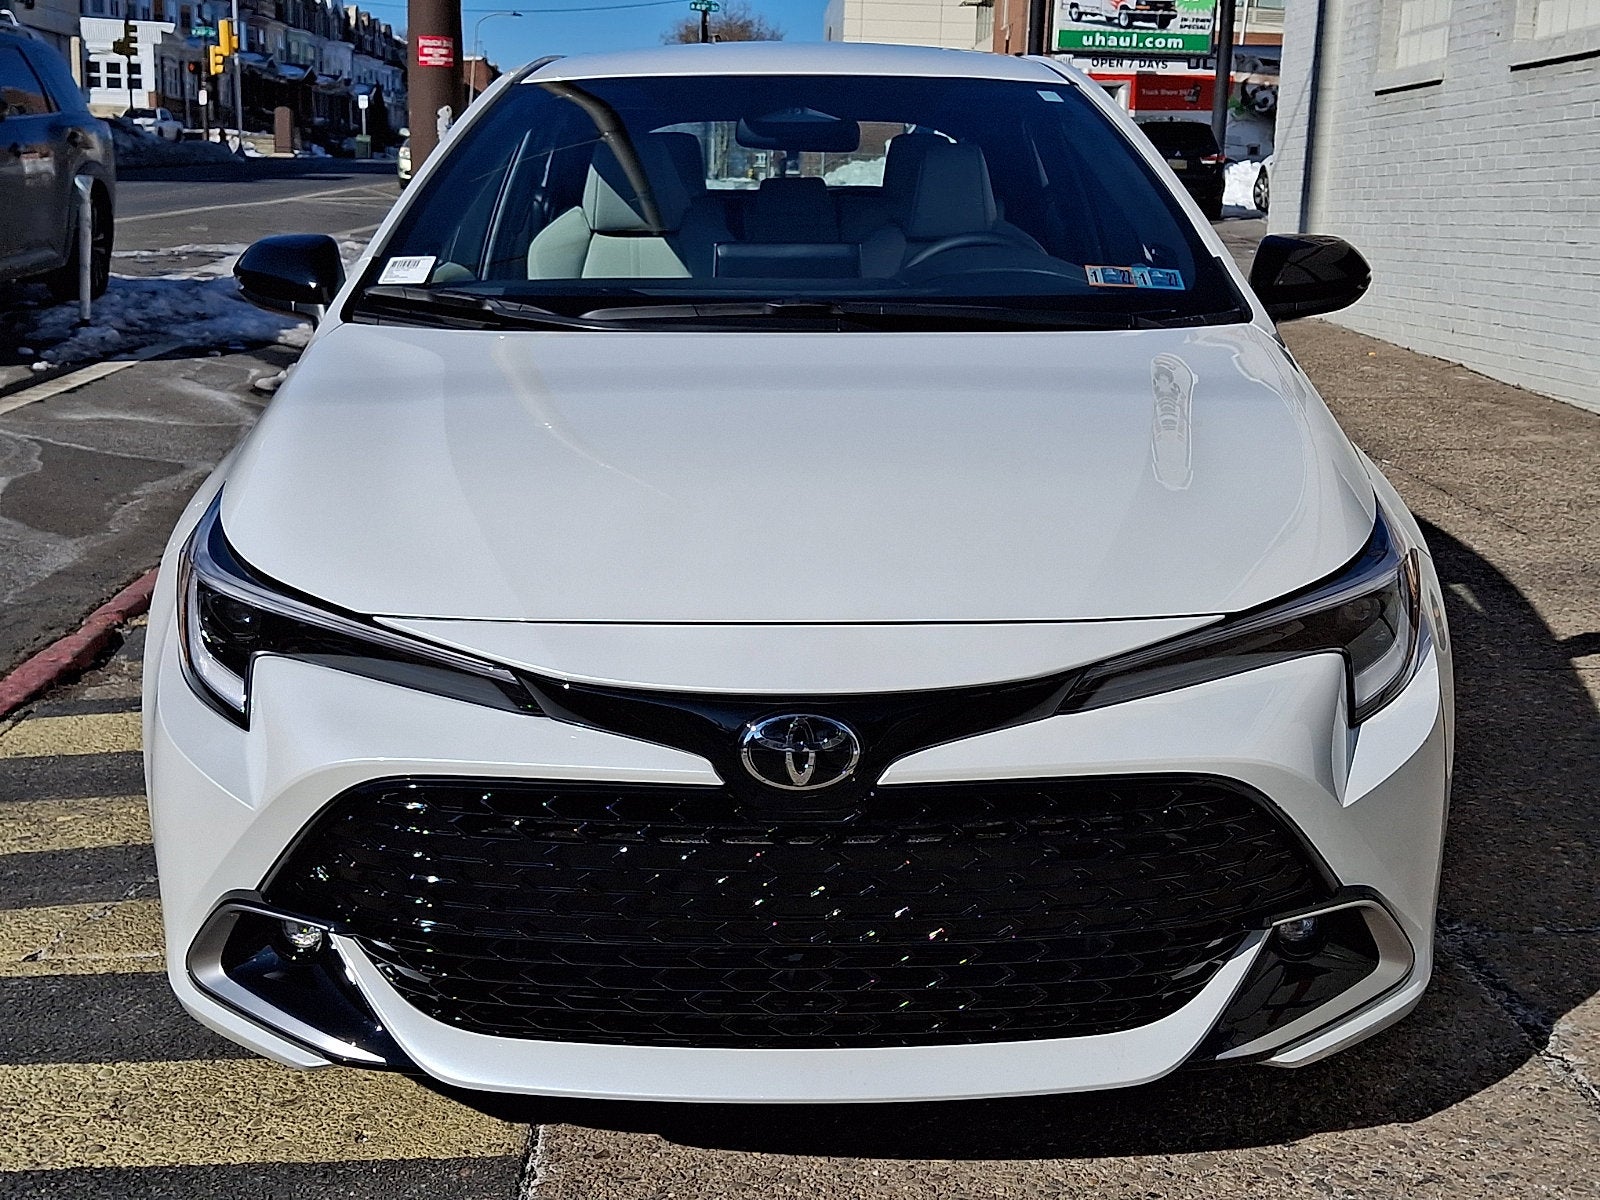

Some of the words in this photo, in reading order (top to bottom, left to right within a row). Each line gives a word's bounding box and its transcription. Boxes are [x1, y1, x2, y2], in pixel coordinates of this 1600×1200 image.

[1082, 32, 1184, 49] uhaul.com
[1091, 57, 1123, 68] OPEN
[1127, 58, 1135, 68] 7
[1139, 58, 1168, 69] DAYS
